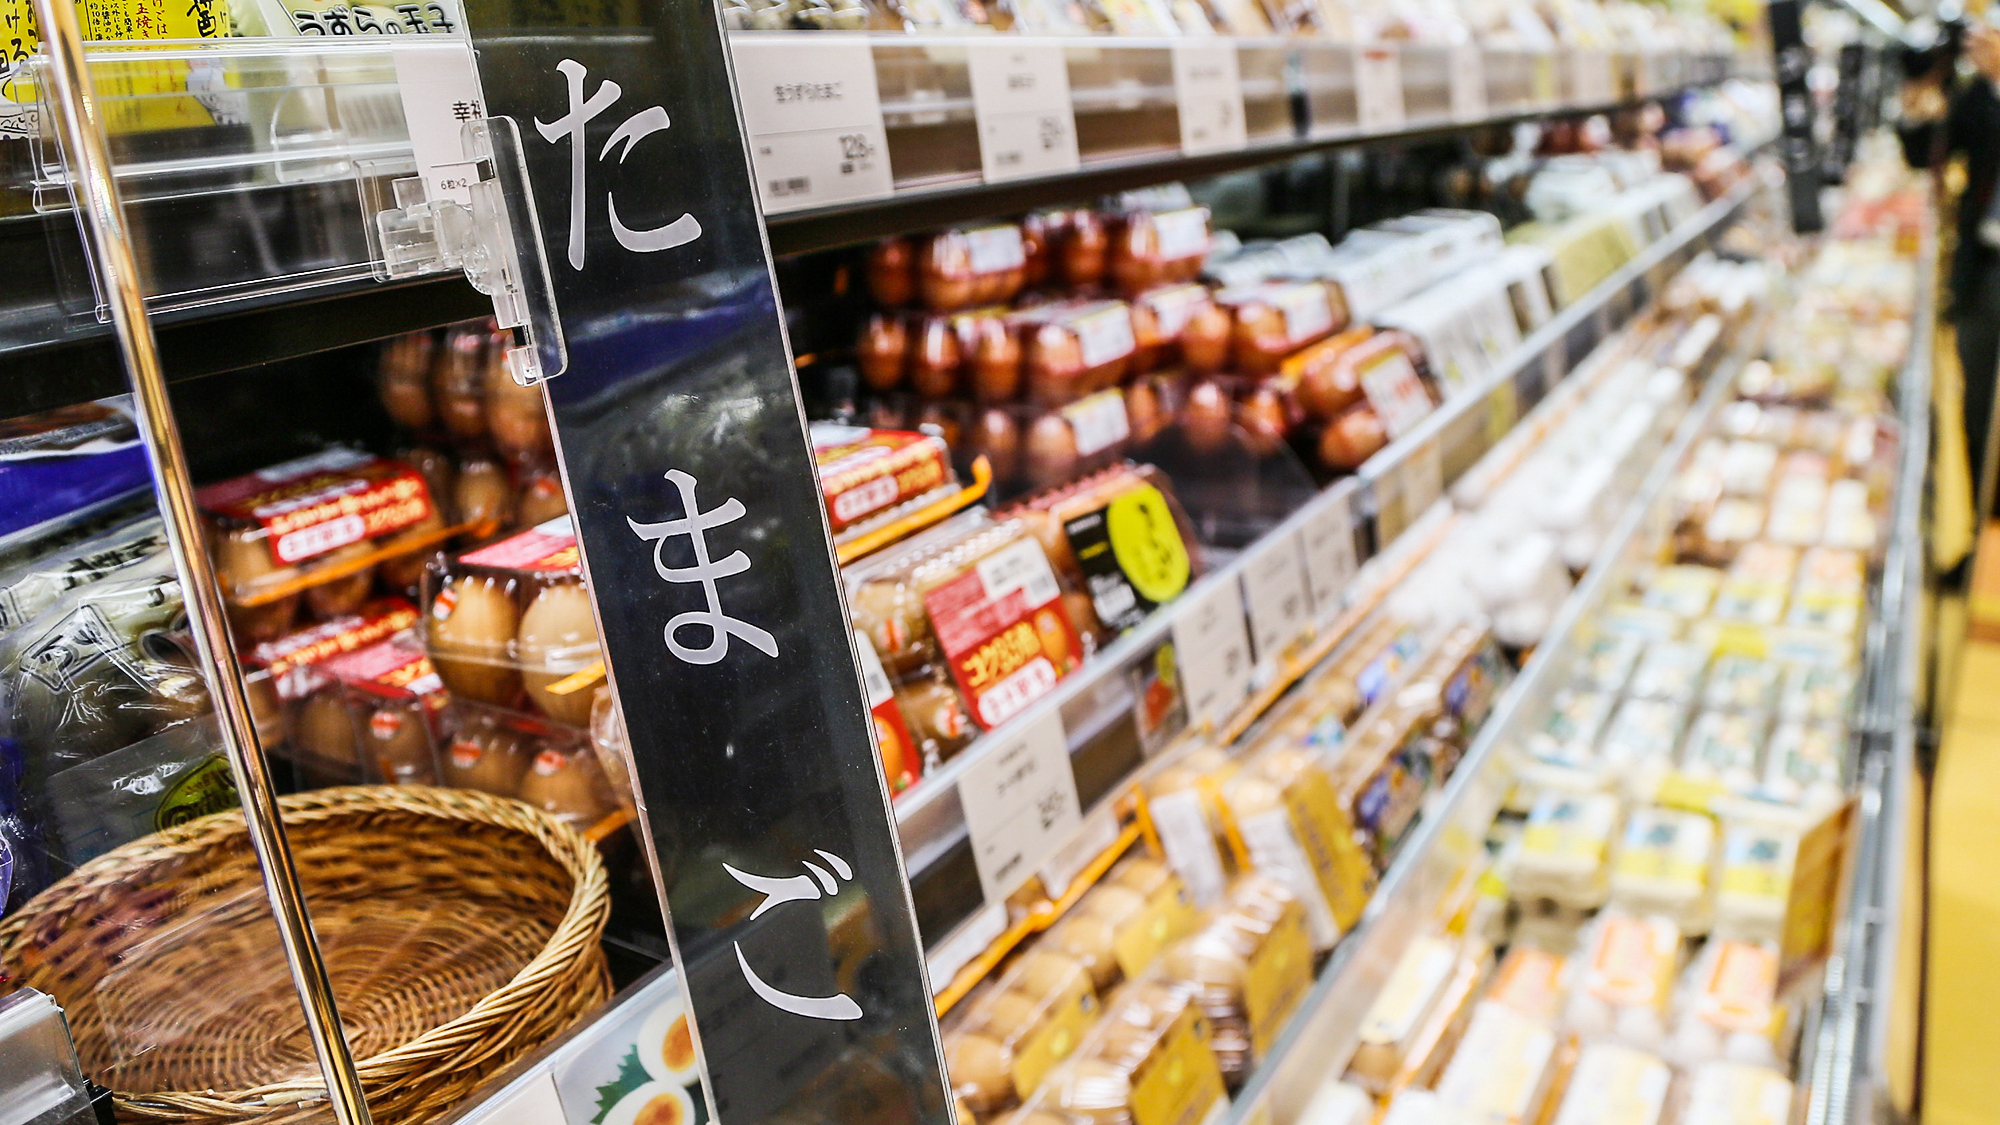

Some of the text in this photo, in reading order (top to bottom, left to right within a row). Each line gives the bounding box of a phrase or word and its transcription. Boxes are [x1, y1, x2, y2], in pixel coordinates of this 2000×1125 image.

[5, 0, 29, 65] ける
[293, 3, 455, 35] うずらの玉子
[534, 58, 864, 1021] たまご
